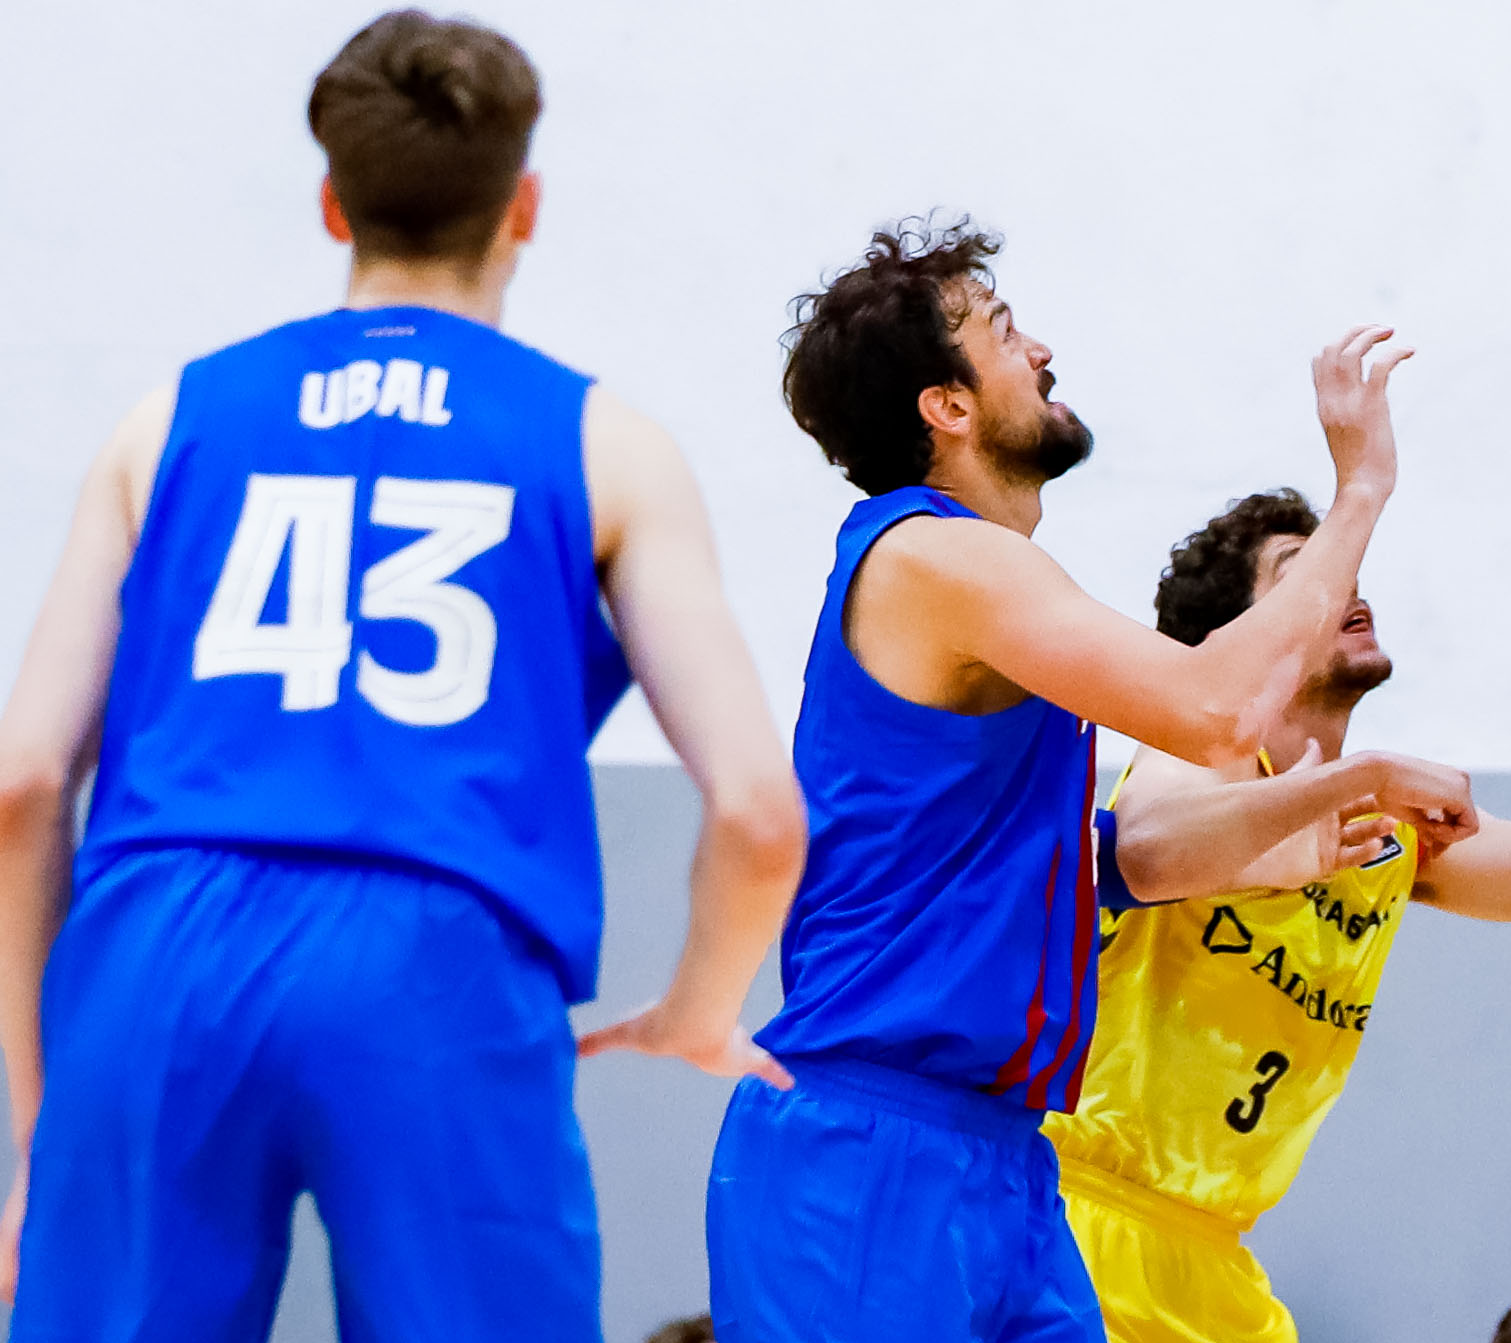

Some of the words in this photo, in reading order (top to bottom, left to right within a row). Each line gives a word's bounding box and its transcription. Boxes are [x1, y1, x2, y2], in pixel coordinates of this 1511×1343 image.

[299, 358, 452, 430] UBAL
[192, 472, 516, 727] 43
[1225, 1050, 1290, 1134] 3
